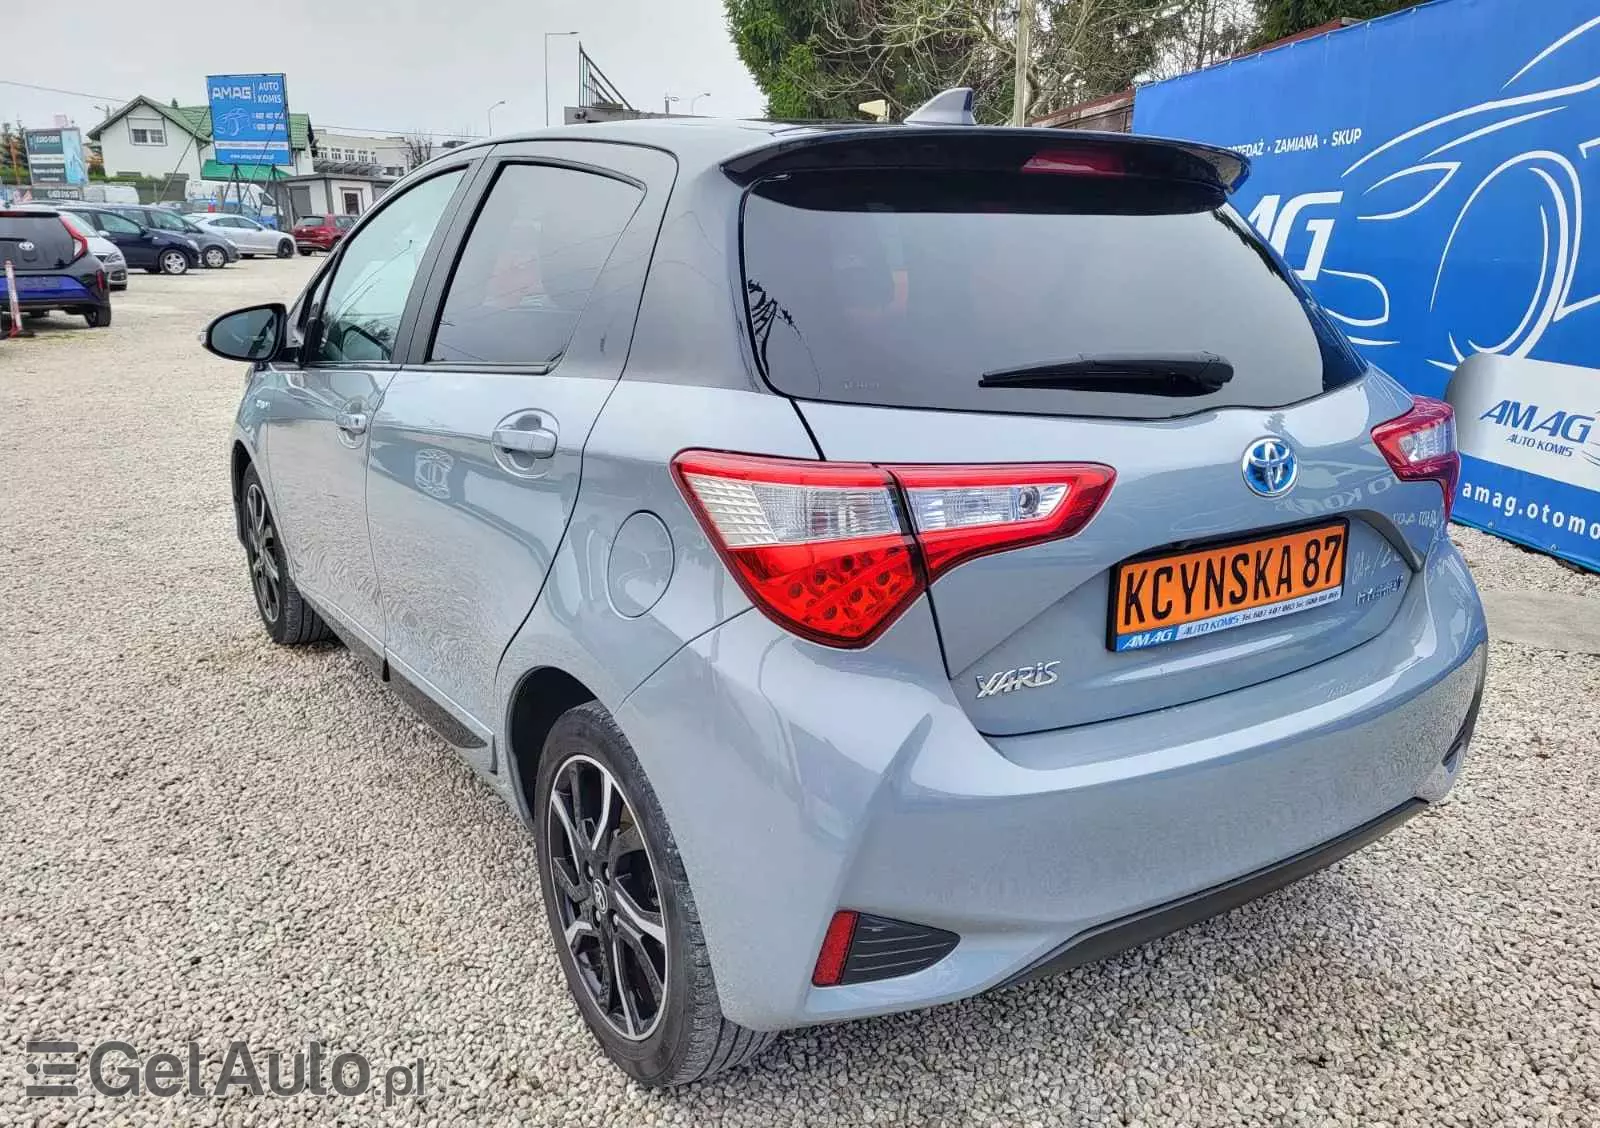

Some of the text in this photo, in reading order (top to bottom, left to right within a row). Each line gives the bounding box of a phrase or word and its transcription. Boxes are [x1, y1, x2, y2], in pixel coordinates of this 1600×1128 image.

[212, 86, 252, 101] AMAG
[259, 81, 279, 92] AUTO
[1274, 134, 1318, 154] ZAMIANA
[1331, 128, 1362, 147] SKUP
[1480, 400, 1595, 443] AMAG
[1506, 433, 1575, 457] AUTO KOMIS
[1124, 545, 1292, 626] KCYNSKA
[1302, 534, 1342, 589] 87
[1122, 629, 1173, 649] AMAG
[1184, 621, 1208, 635] AUTO
